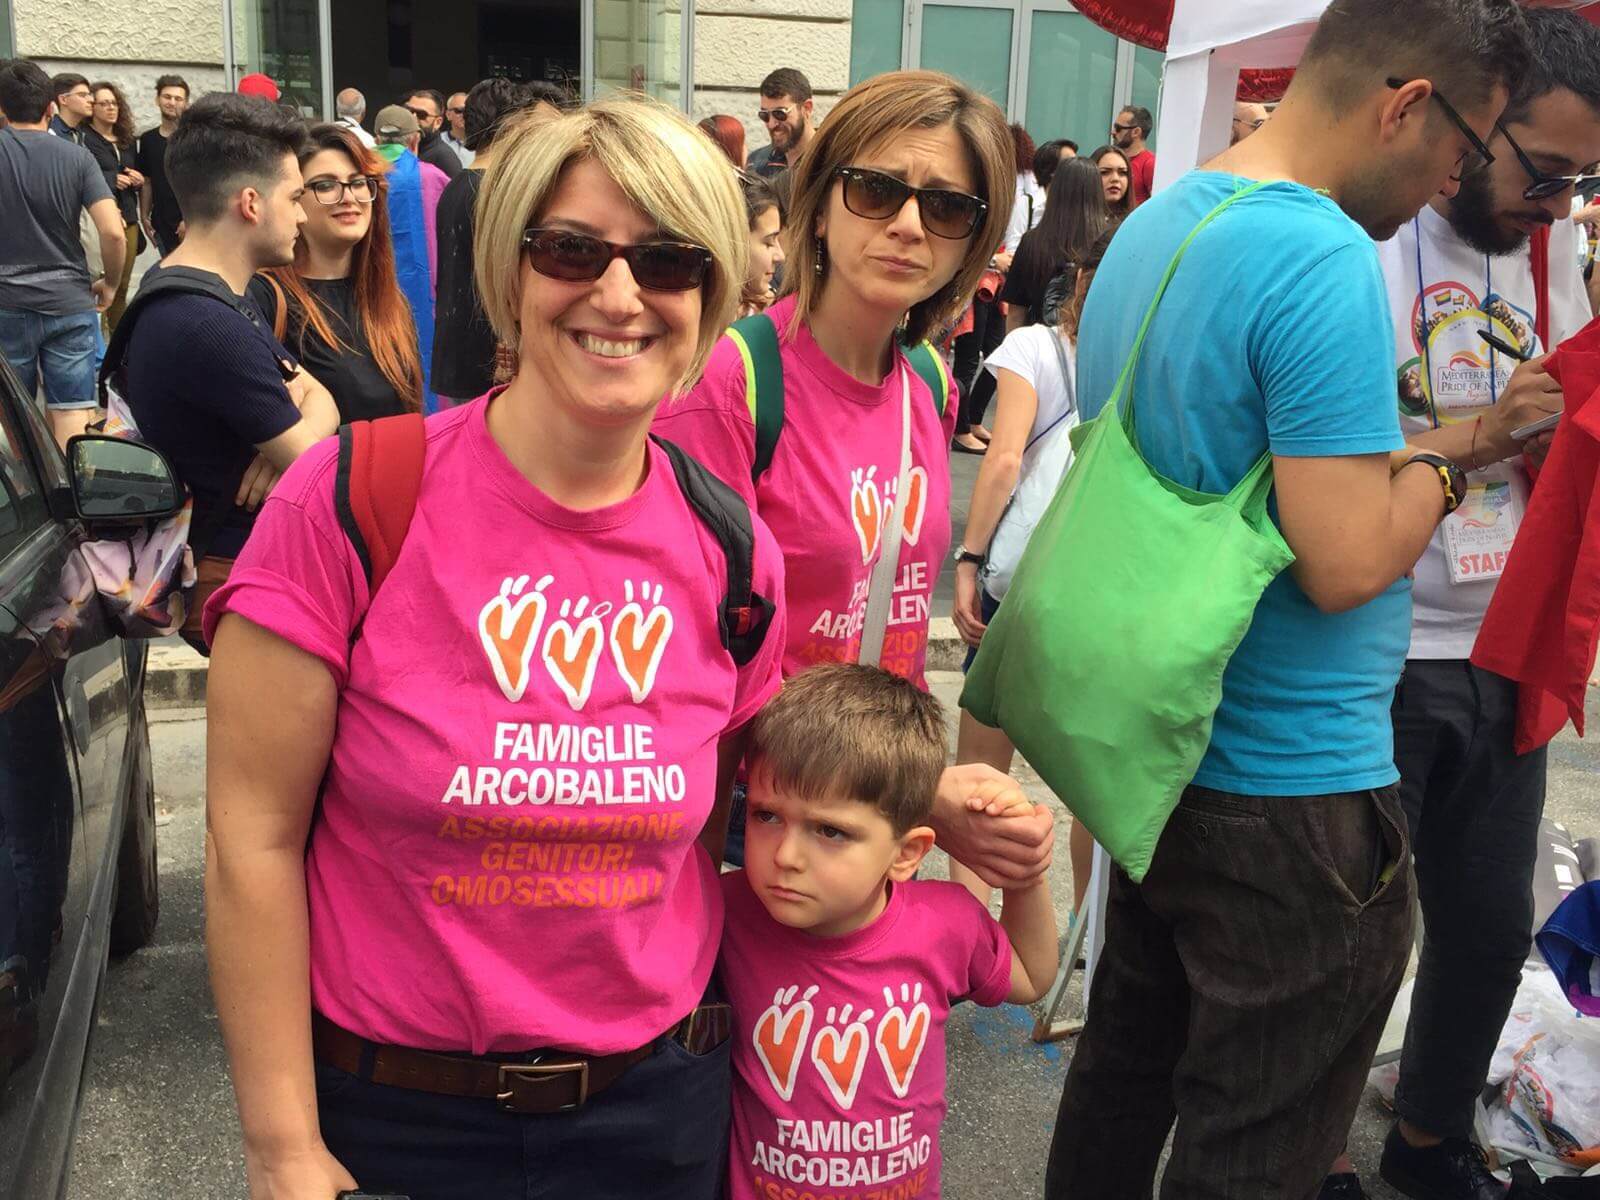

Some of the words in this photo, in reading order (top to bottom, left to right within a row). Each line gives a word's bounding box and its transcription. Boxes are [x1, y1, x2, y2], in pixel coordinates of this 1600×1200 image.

[1459, 550, 1510, 575] STAF
[493, 721, 656, 764] FAMIGLIE
[441, 764, 686, 806] ARCOBALENO
[437, 812, 685, 842] ASSOCIAZIONE
[481, 842, 634, 873] GENITORI
[776, 1112, 914, 1153] FAMIGLIE
[752, 1134, 931, 1187] ARCOBALENO
